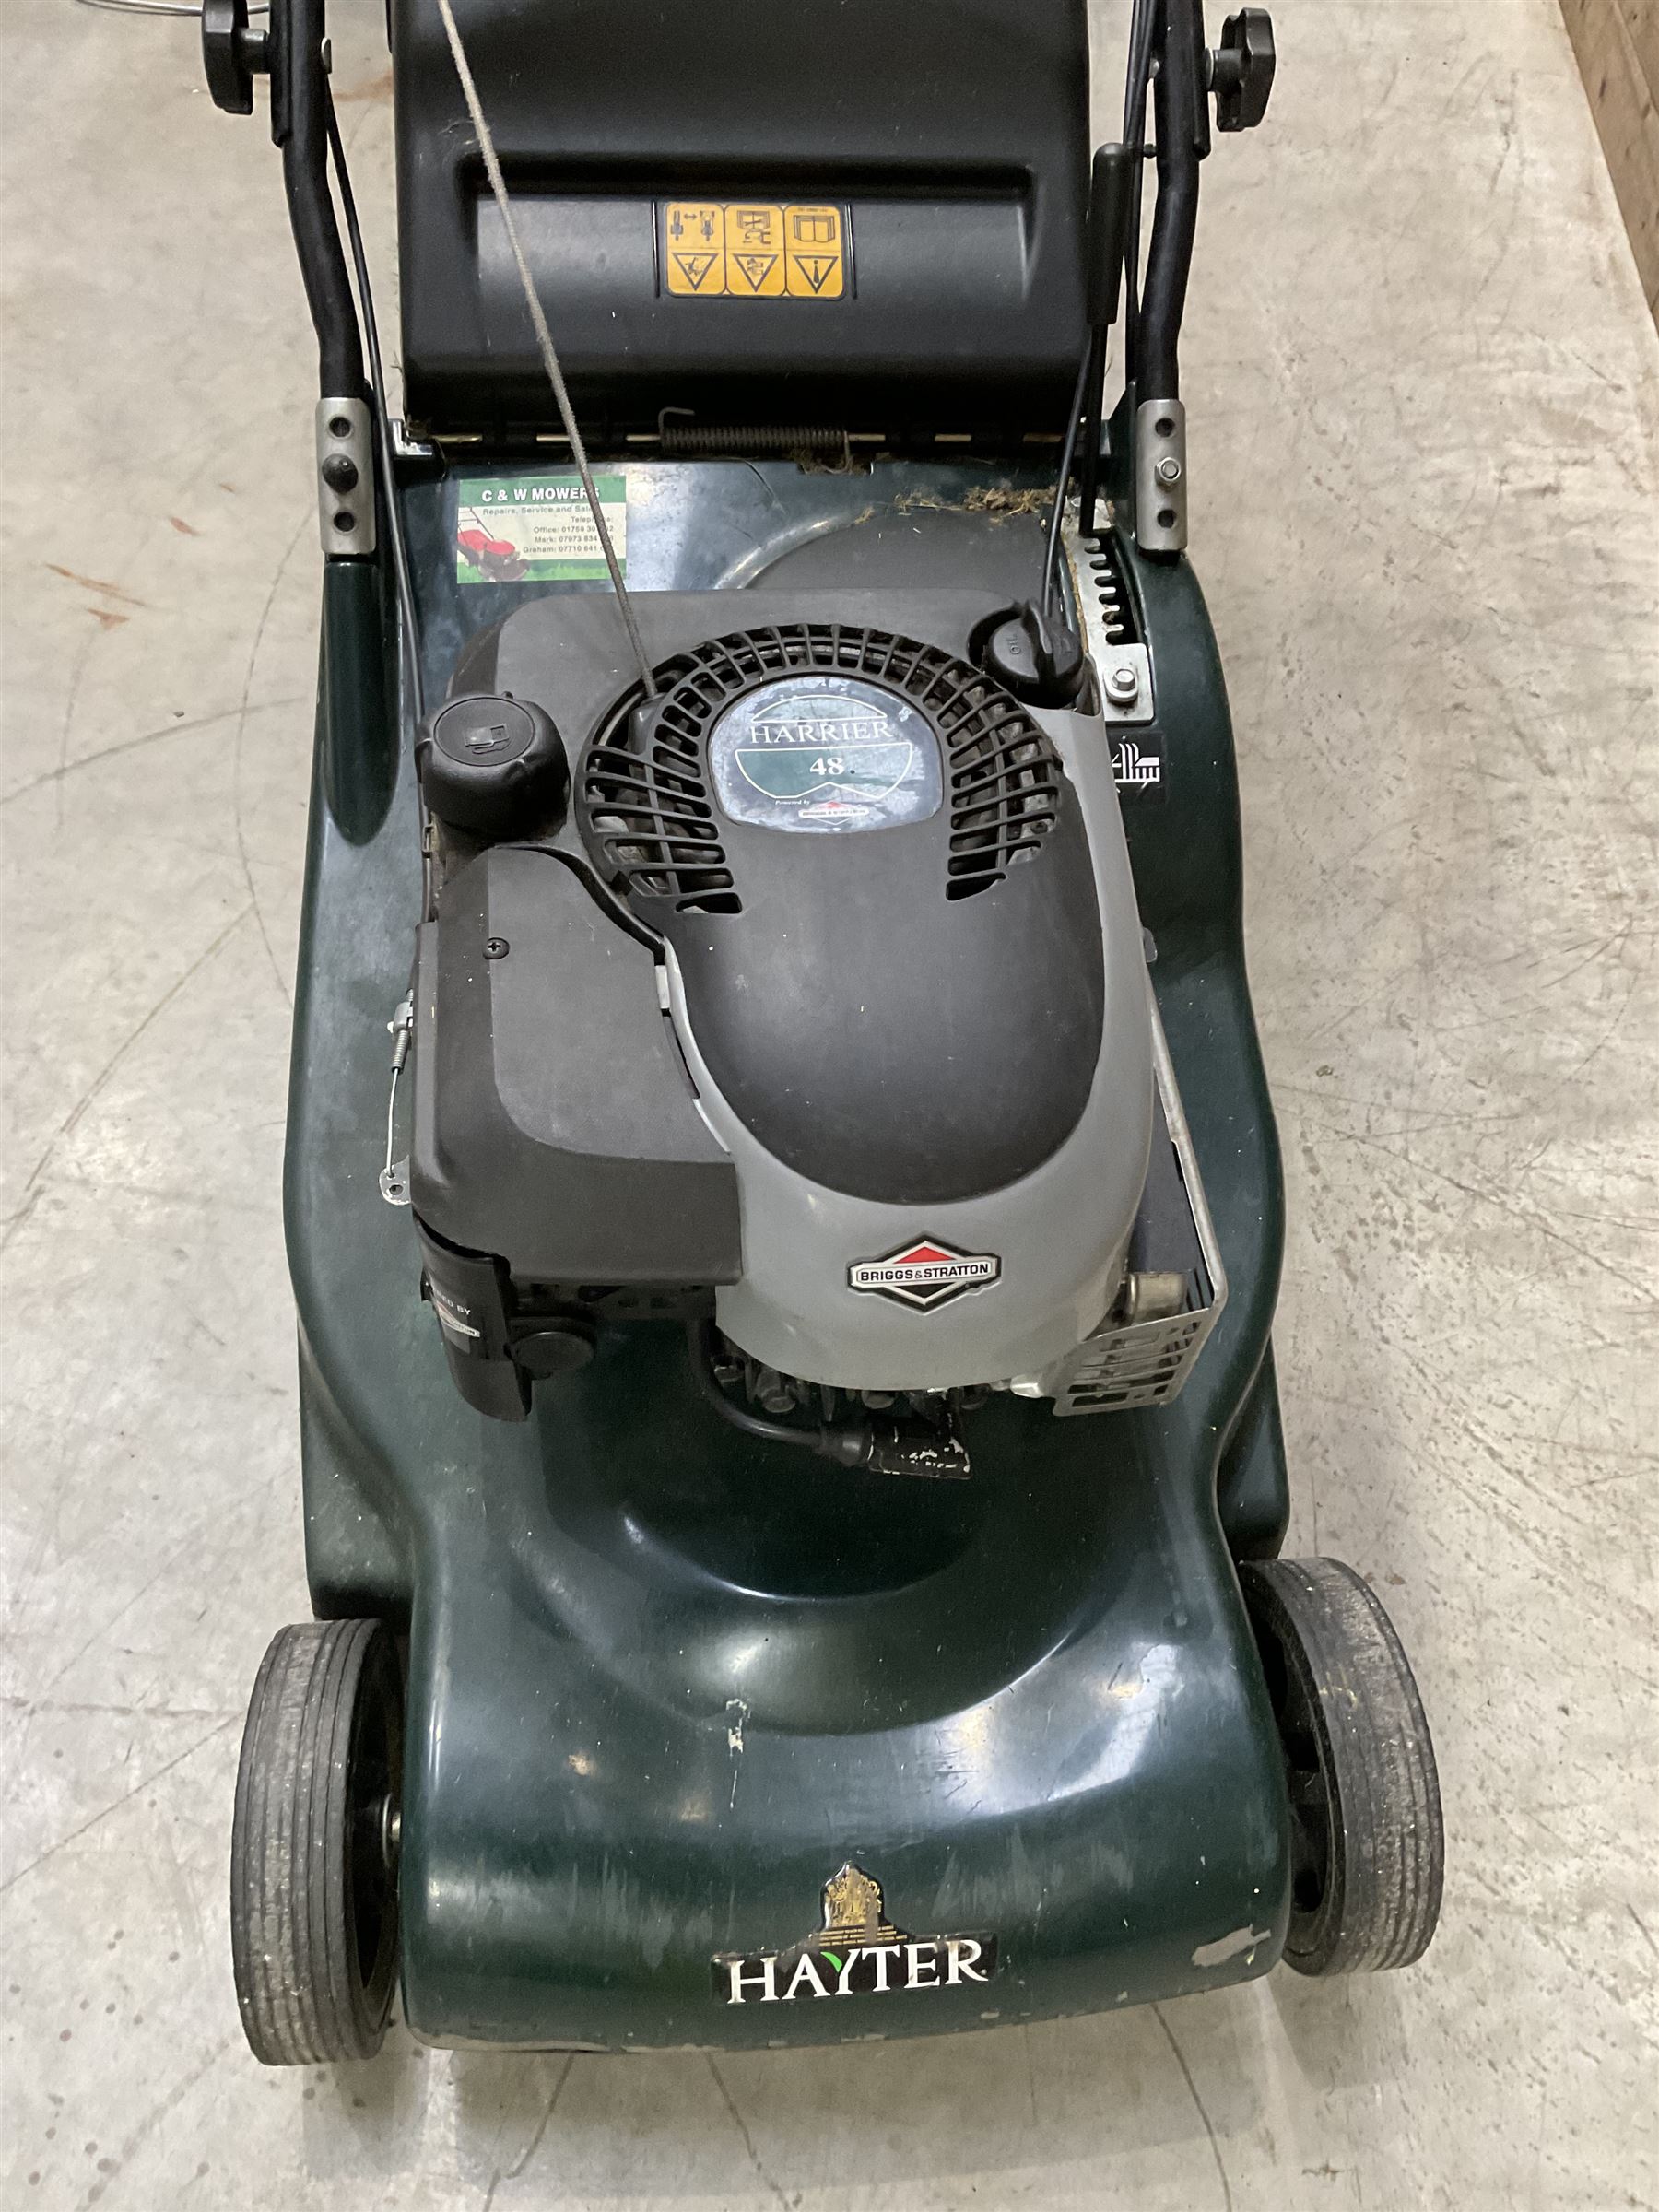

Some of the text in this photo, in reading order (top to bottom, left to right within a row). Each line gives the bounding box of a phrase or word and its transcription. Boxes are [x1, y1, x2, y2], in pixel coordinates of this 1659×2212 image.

[482, 489, 492, 502] C
[497, 489, 508, 501] &
[513, 488, 527, 500] W
[521, 506, 554, 514] Service
[750, 721, 894, 744] HARRIER
[809, 757, 844, 775] 48
[727, 1939, 989, 2004] HAYTER
